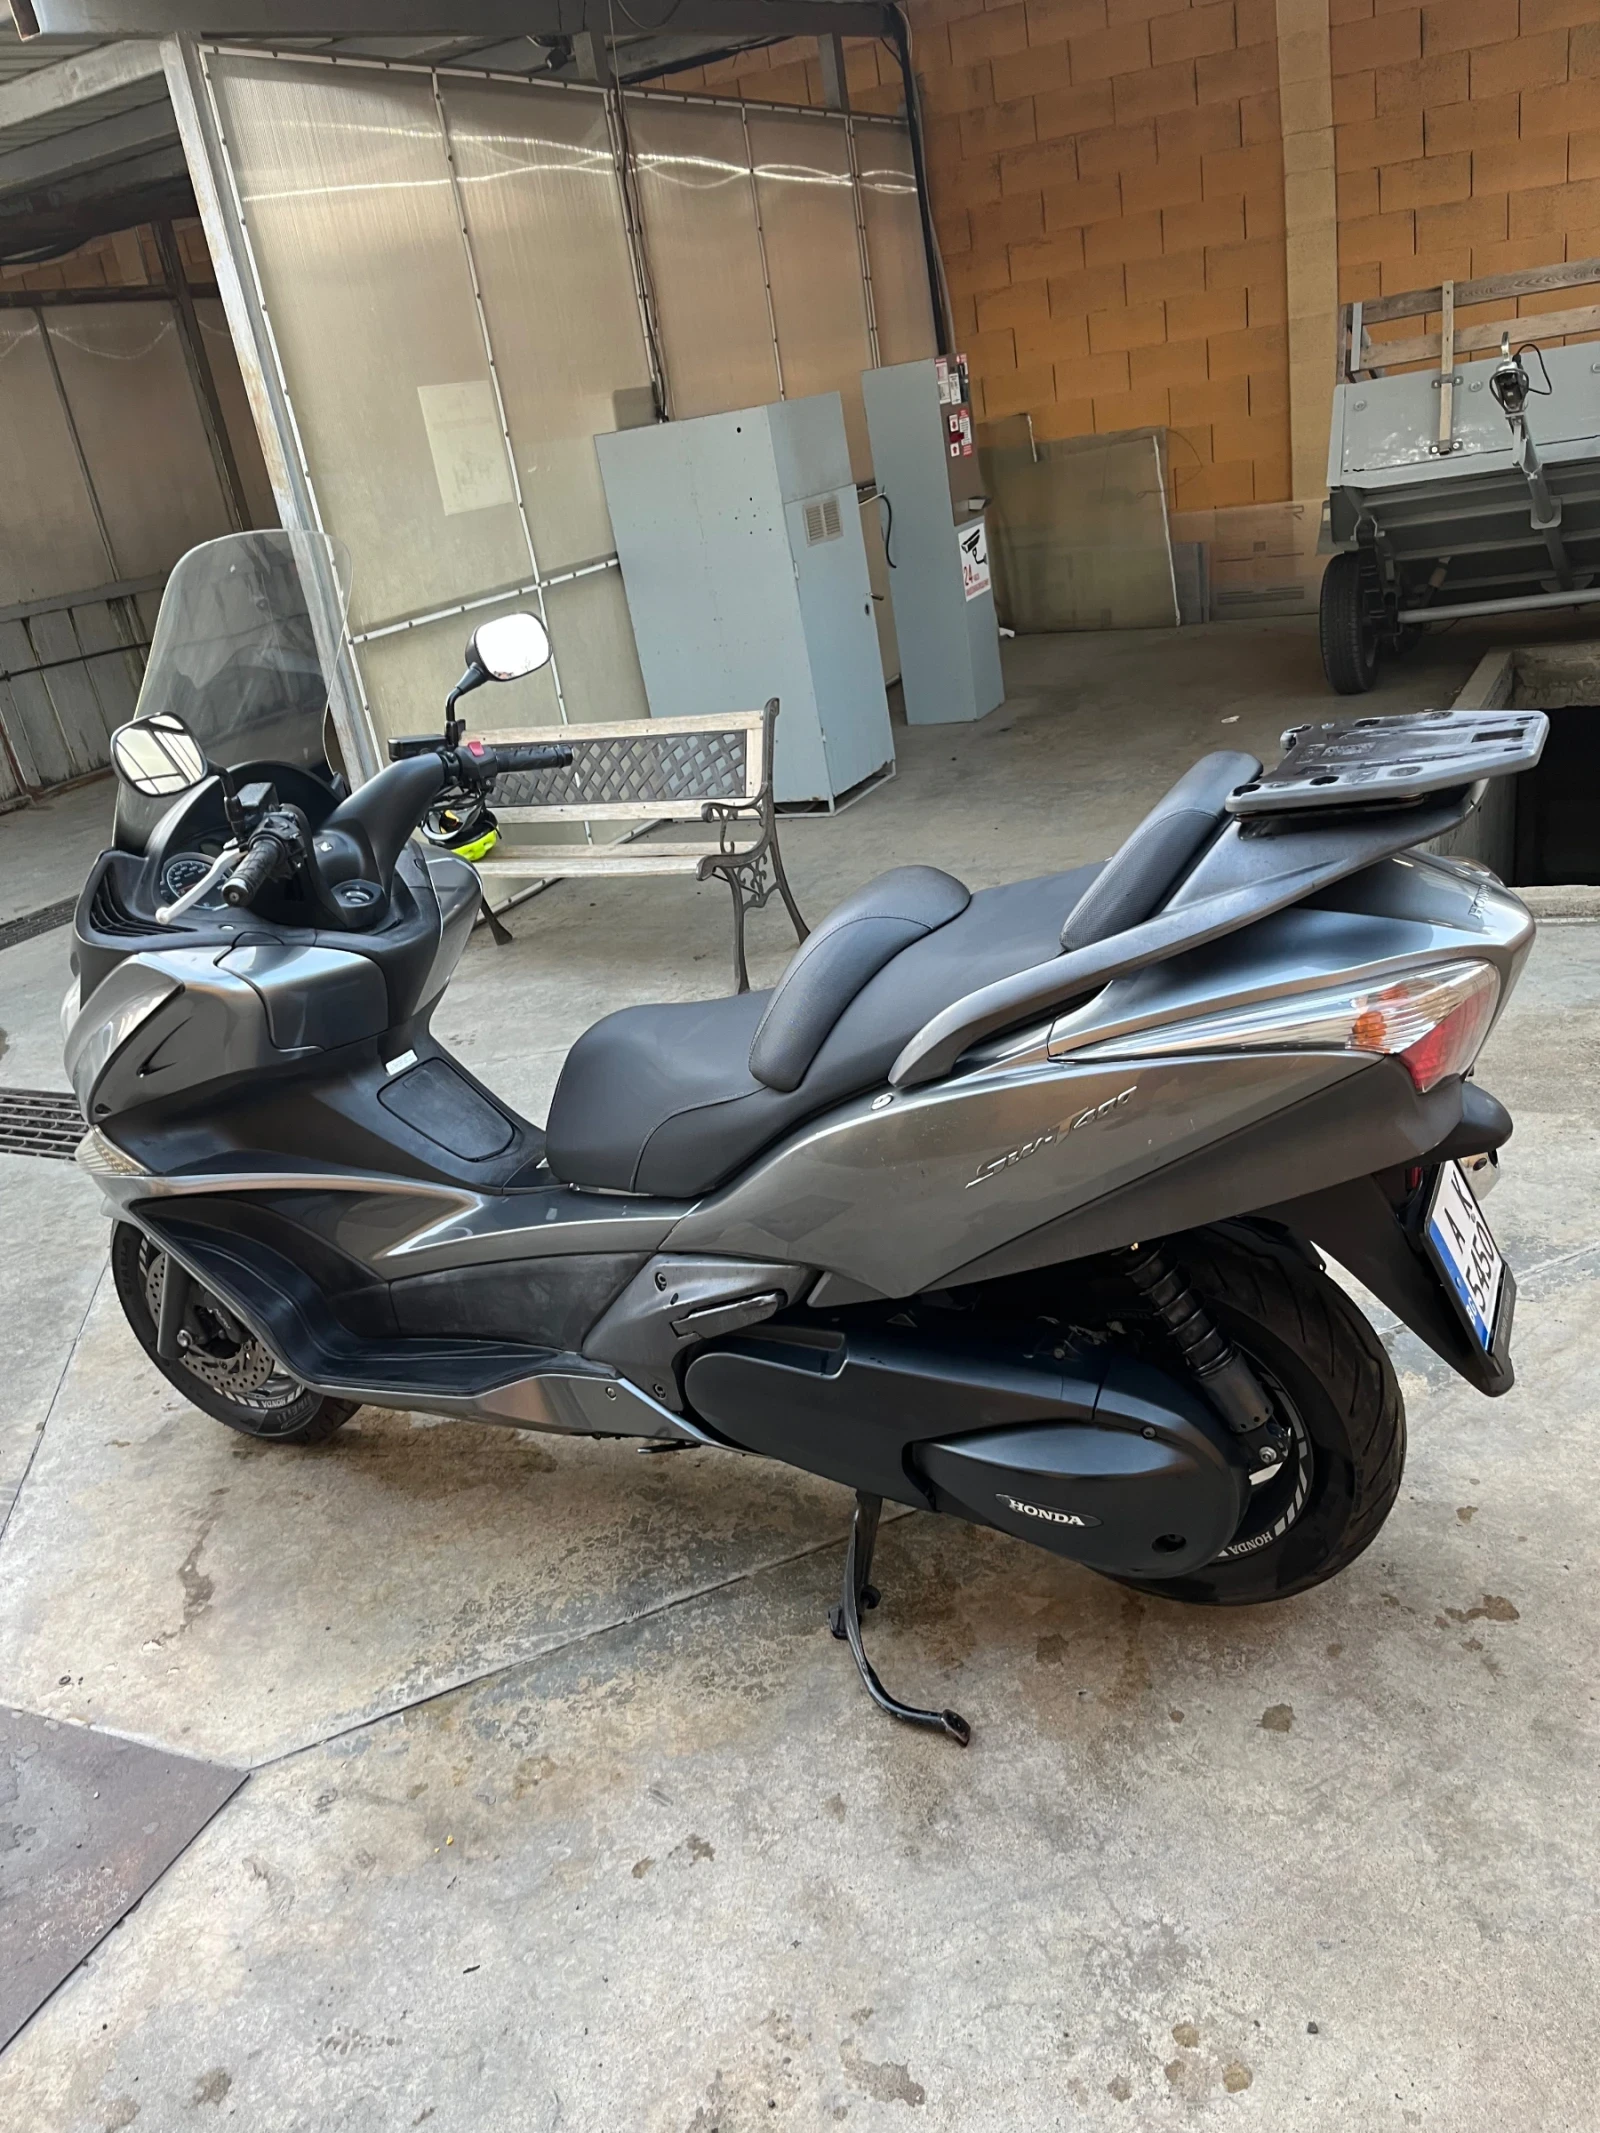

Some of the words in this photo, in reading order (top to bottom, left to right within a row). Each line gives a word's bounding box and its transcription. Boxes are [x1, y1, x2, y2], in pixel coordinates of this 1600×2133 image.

[963, 563, 974, 586] 24
[1451, 1170, 1473, 1219] K
[1444, 1208, 1466, 1255] A
[1467, 1221, 1494, 1313] 5450
[1466, 1297, 1478, 1325] BG
[261, 1398, 286, 1409] HONDA
[1008, 1498, 1085, 1526] HONDA
[1228, 1531, 1273, 1555] HONDA
